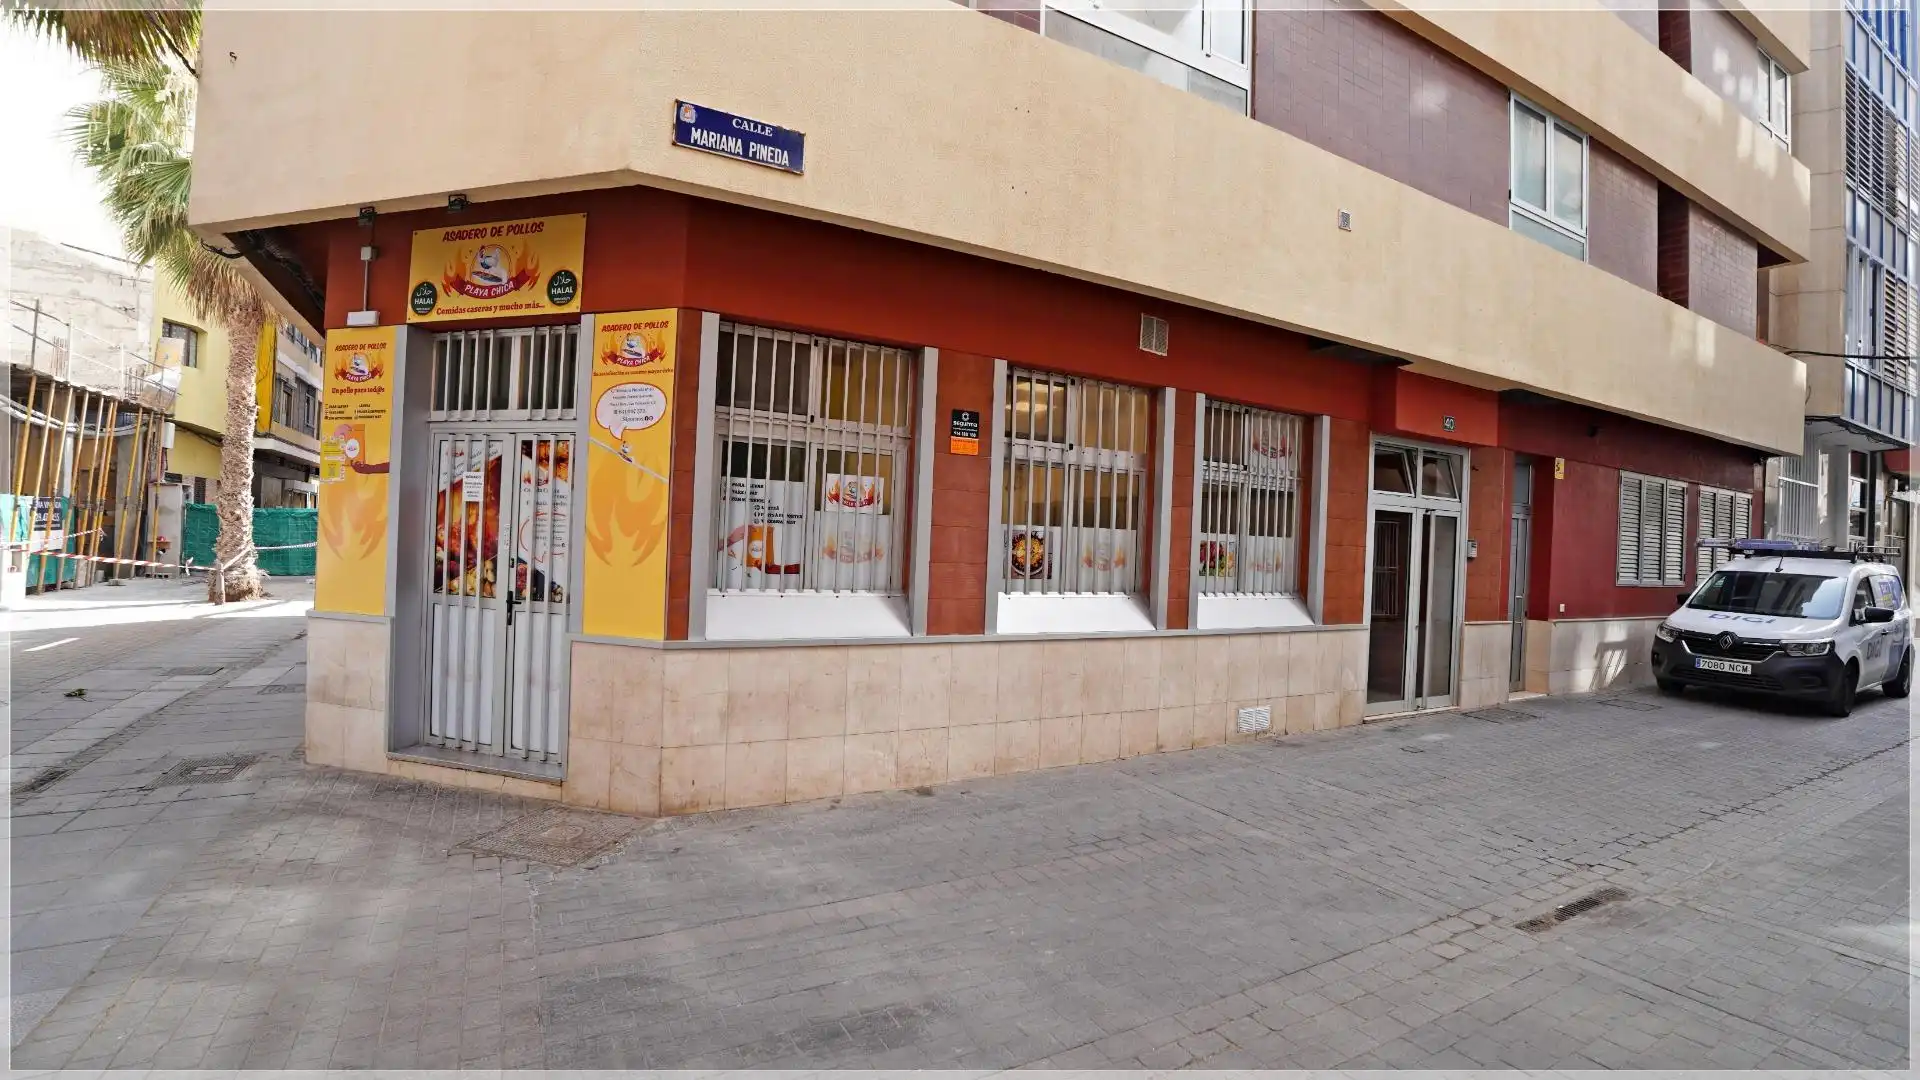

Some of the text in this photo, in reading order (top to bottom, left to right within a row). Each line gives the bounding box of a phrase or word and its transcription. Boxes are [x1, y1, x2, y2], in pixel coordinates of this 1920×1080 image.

[732, 118, 773, 137] CALLE
[690, 127, 790, 167] MARIANA PINEDA
[442, 222, 544, 242] ASADERO DE POLLOS
[464, 281, 515, 297] PLAYA CHICA
[551, 286, 573, 295] HALAL
[414, 297, 433, 305] HALAL
[436, 304, 466, 316] Comidas
[467, 304, 492, 314] caseras
[499, 301, 524, 311] mucho
[602, 320, 669, 333] ASADERO DE POLLOS
[1445, 417, 1455, 429] 40
[1701, 659, 1748, 673] 7080 NCM
